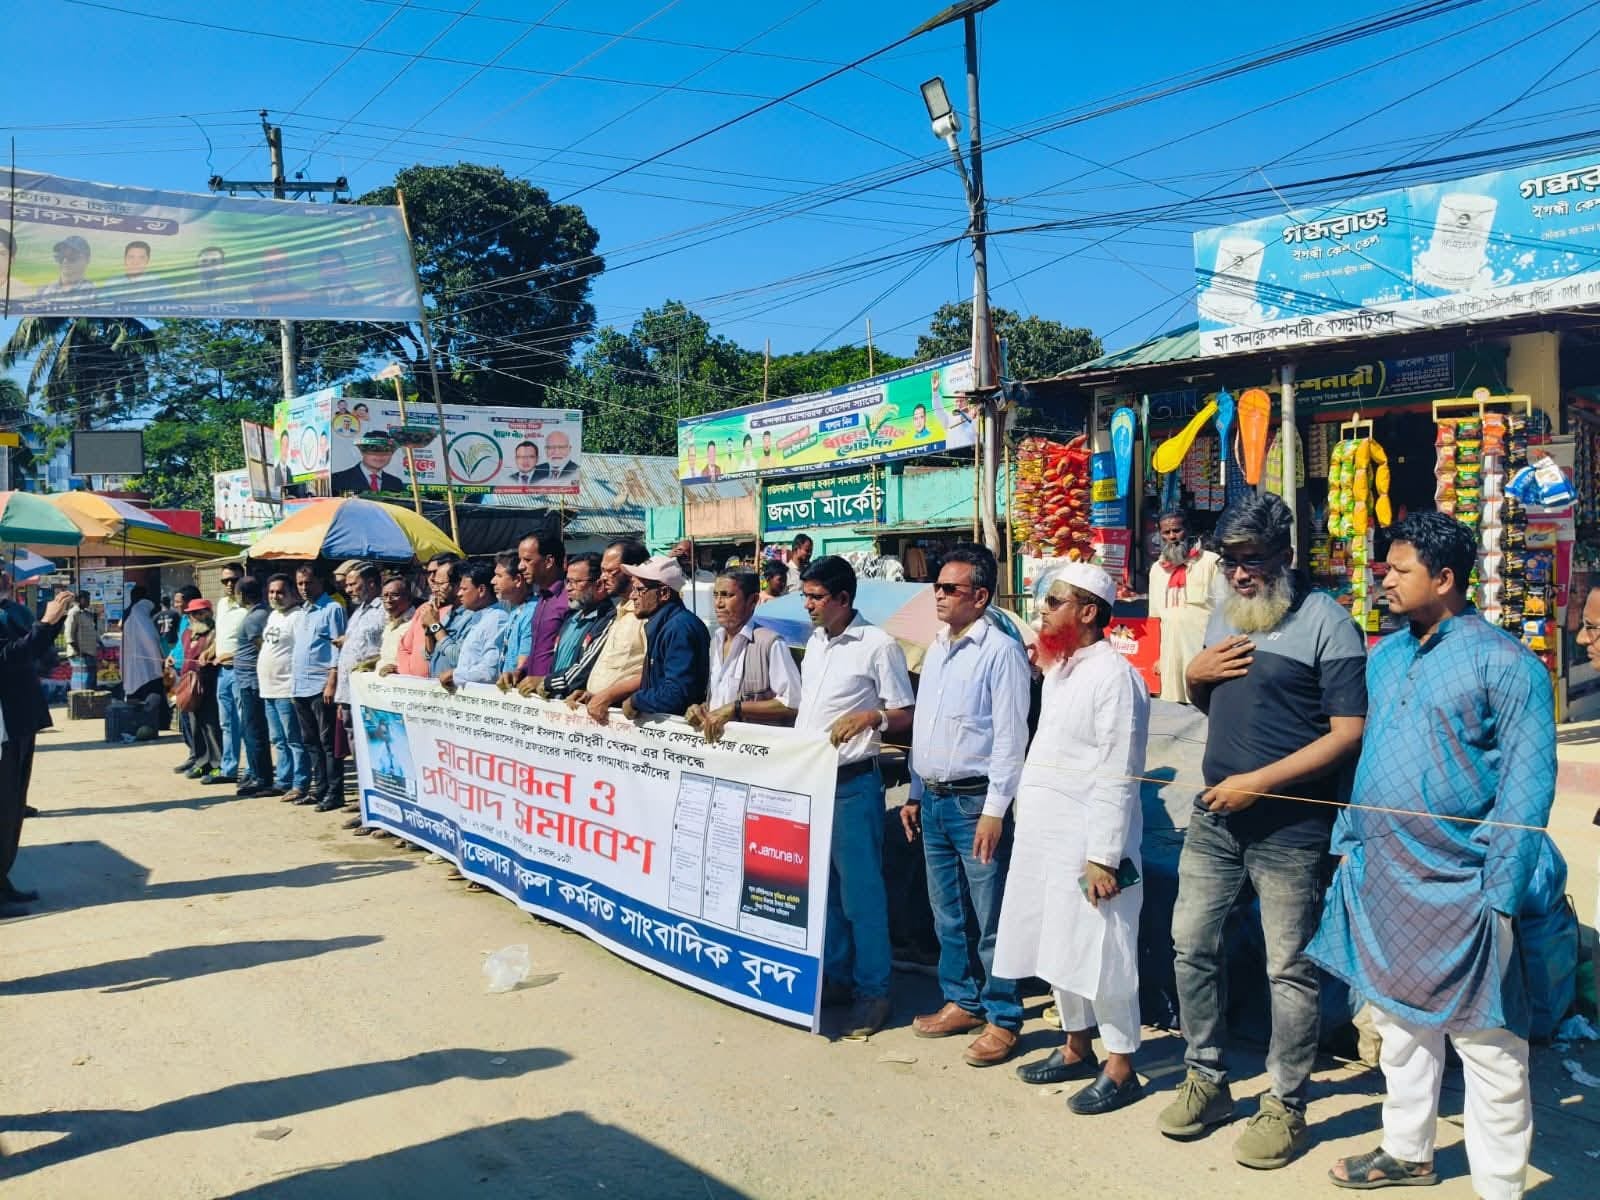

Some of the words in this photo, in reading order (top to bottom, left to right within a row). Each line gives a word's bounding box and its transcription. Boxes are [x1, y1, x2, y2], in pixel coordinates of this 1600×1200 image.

[1283, 207, 1388, 244] গন্ধরাজ
[1214, 333, 1230, 351] মা
[767, 497, 816, 523] জনতা
[822, 484, 886, 519] মার্কেট
[537, 724, 565, 744] ইসলাম
[569, 727, 604, 748] চৌধুরী
[640, 748, 659, 762] এর
[739, 743, 769, 757] থেকে
[435, 738, 577, 804] মানববন্ধন
[589, 780, 617, 816] ও
[564, 748, 593, 764] দাবিতে
[632, 759, 670, 781] কর্মীদের
[421, 763, 506, 823] প্রতিবাদ
[513, 796, 657, 875] সমাবেশ
[558, 879, 617, 922] কর্মরত
[621, 900, 733, 969] সাংবাদিক
[740, 947, 803, 997] বৃন্দ
